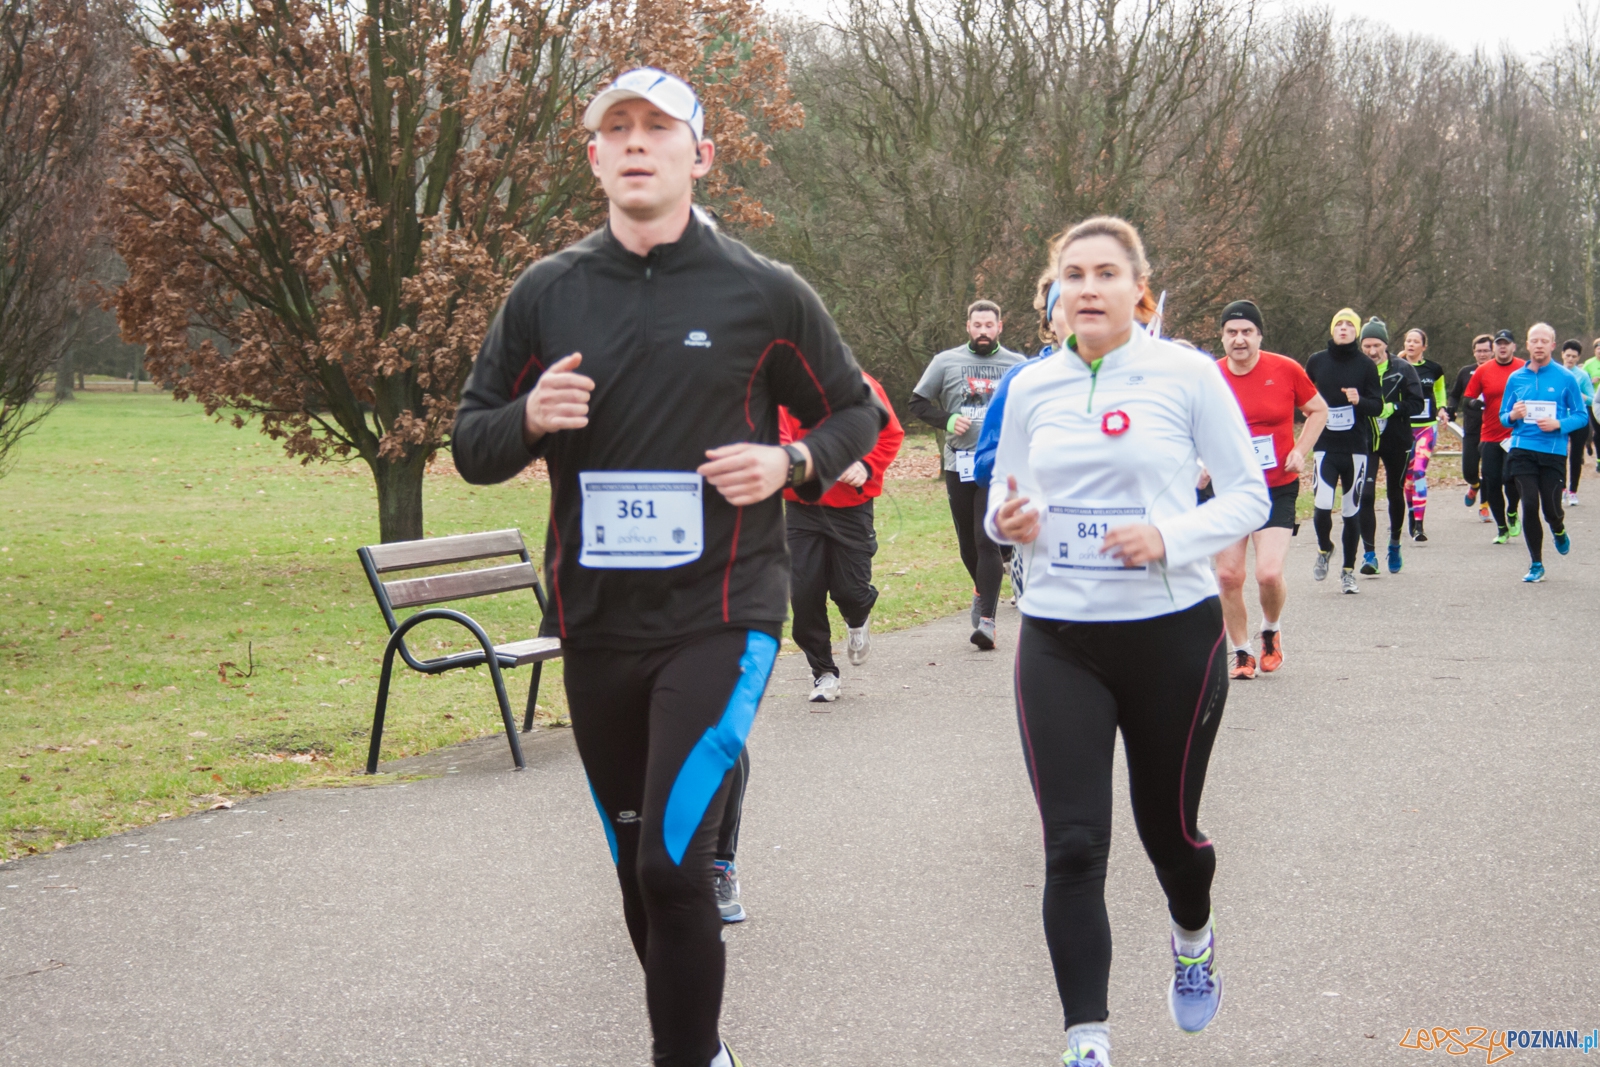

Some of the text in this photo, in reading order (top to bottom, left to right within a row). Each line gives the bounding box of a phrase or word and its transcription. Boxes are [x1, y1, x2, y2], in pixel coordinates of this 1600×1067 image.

[617, 499, 657, 519] 361
[1064, 507, 1091, 515] POWSTANIA
[617, 531, 657, 544] parkrun
[1077, 522, 1108, 539] 841
